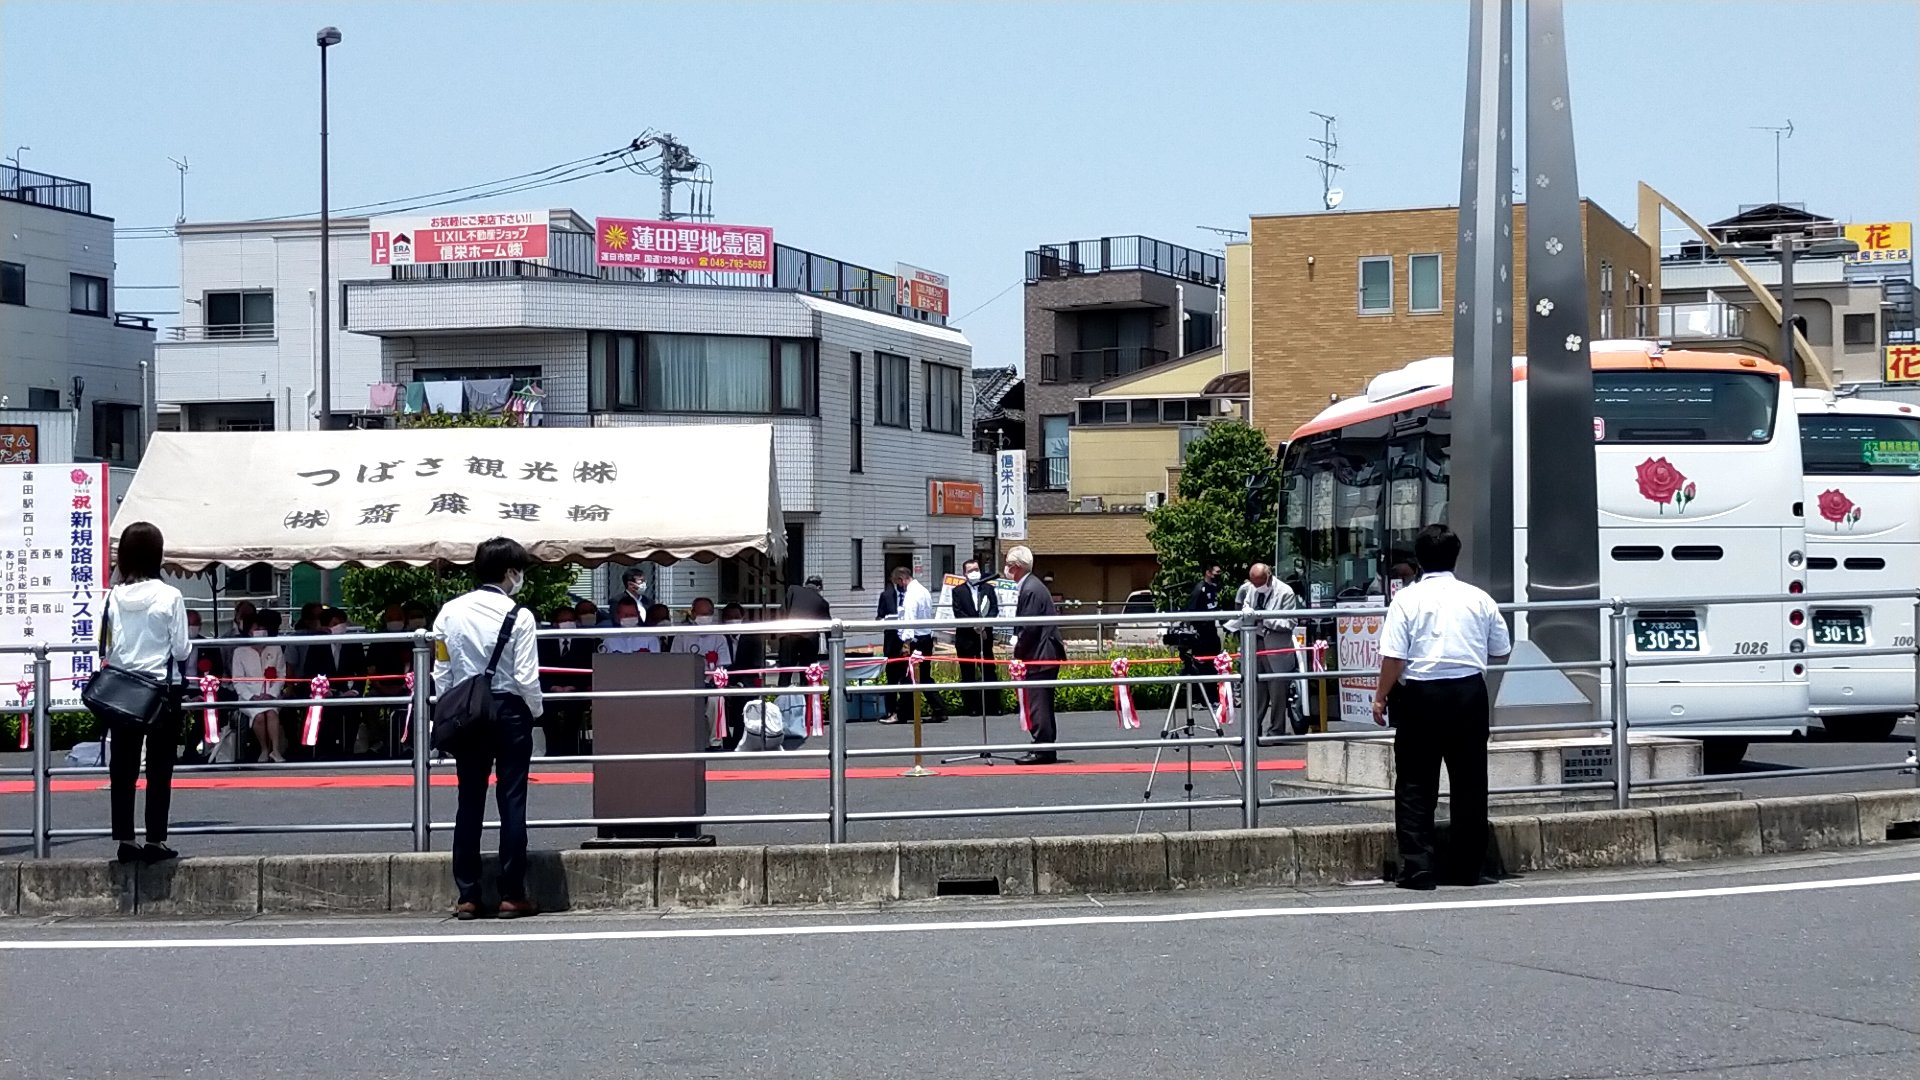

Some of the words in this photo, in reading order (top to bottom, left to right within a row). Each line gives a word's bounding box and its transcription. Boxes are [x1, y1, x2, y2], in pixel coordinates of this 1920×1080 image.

[433, 228, 529, 243] LIXIL不動産ショップ
[631, 226, 765, 256] 蓮田聖地霊園
[1865, 224, 1891, 249] 花
[1889, 347, 1920, 378] 花
[23, 471, 33, 536] 蓮田駅西口
[72, 495, 92, 509] 祝
[31, 549, 39, 613] 西白岡
[1645, 630, 1697, 649] 30-55
[1821, 625, 1864, 642] 30-13
[1732, 641, 1768, 655] 1026
